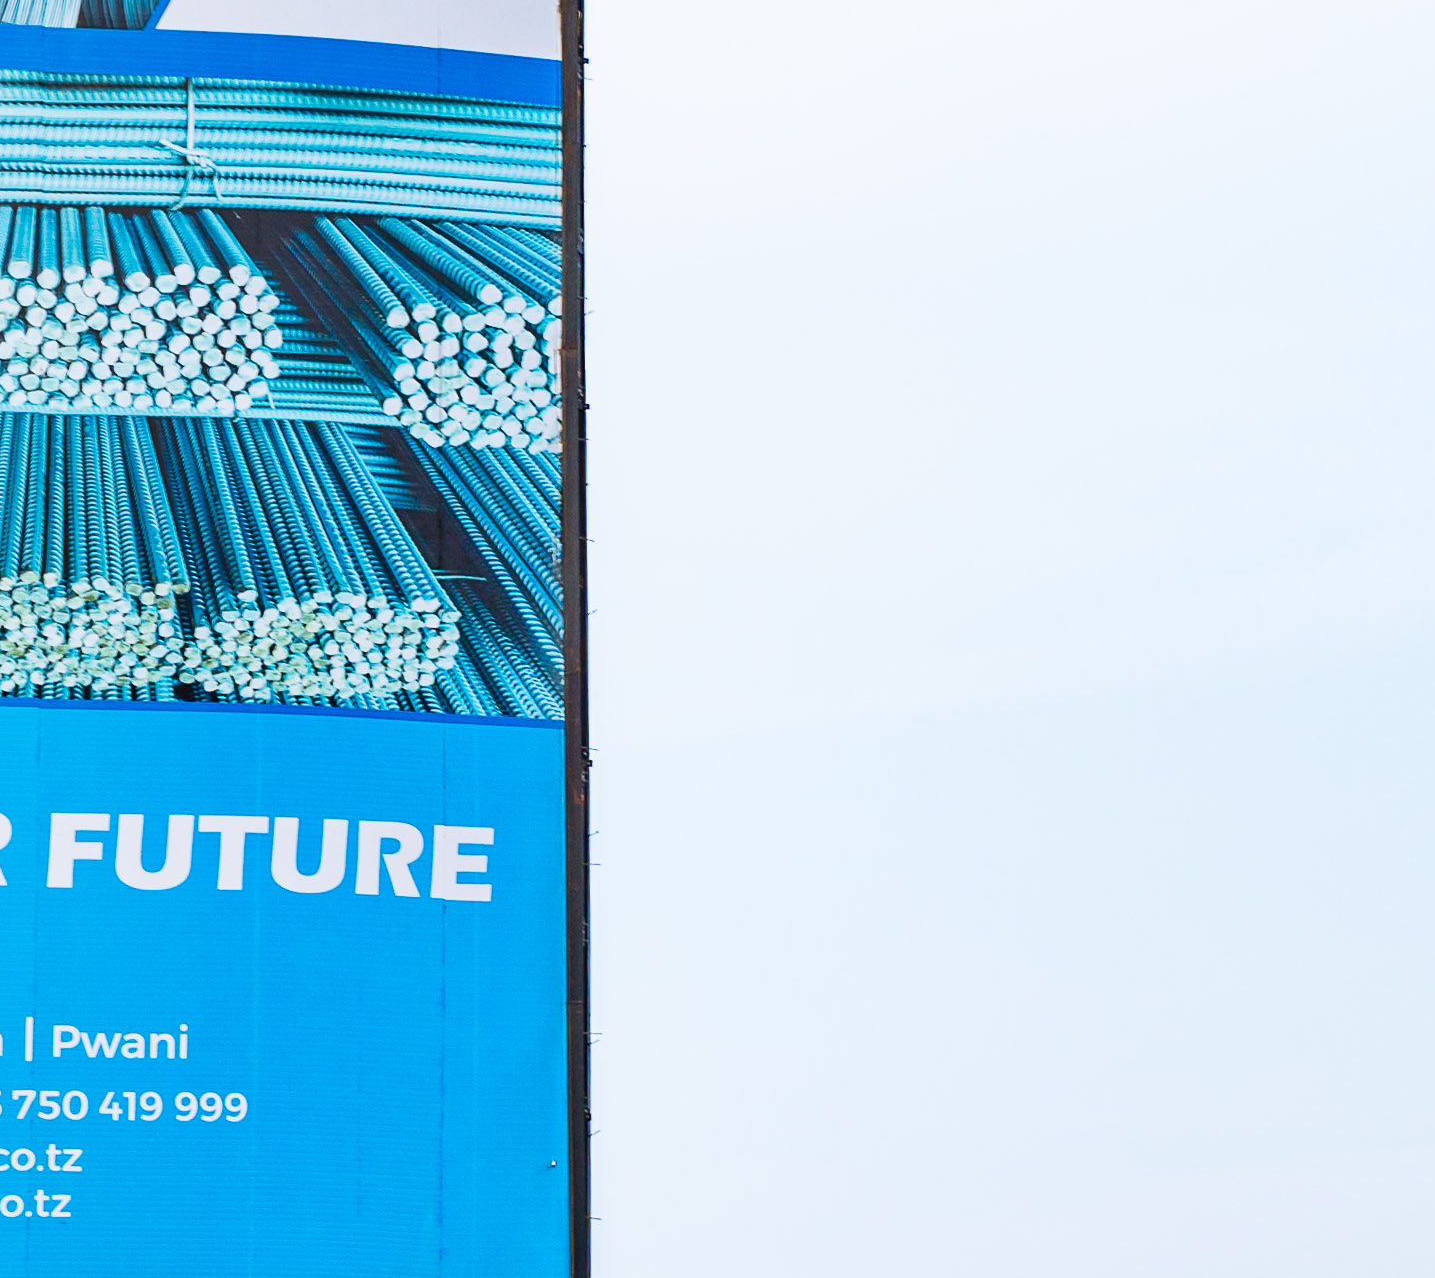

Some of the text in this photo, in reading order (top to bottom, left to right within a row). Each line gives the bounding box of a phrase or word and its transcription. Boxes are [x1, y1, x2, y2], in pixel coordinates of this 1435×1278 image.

[45, 813, 495, 903] FUTURE
[52, 1023, 189, 1060] Pwani
[12, 1089, 88, 1120] 750
[98, 1091, 163, 1122] 419
[174, 1092, 248, 1123] 999
